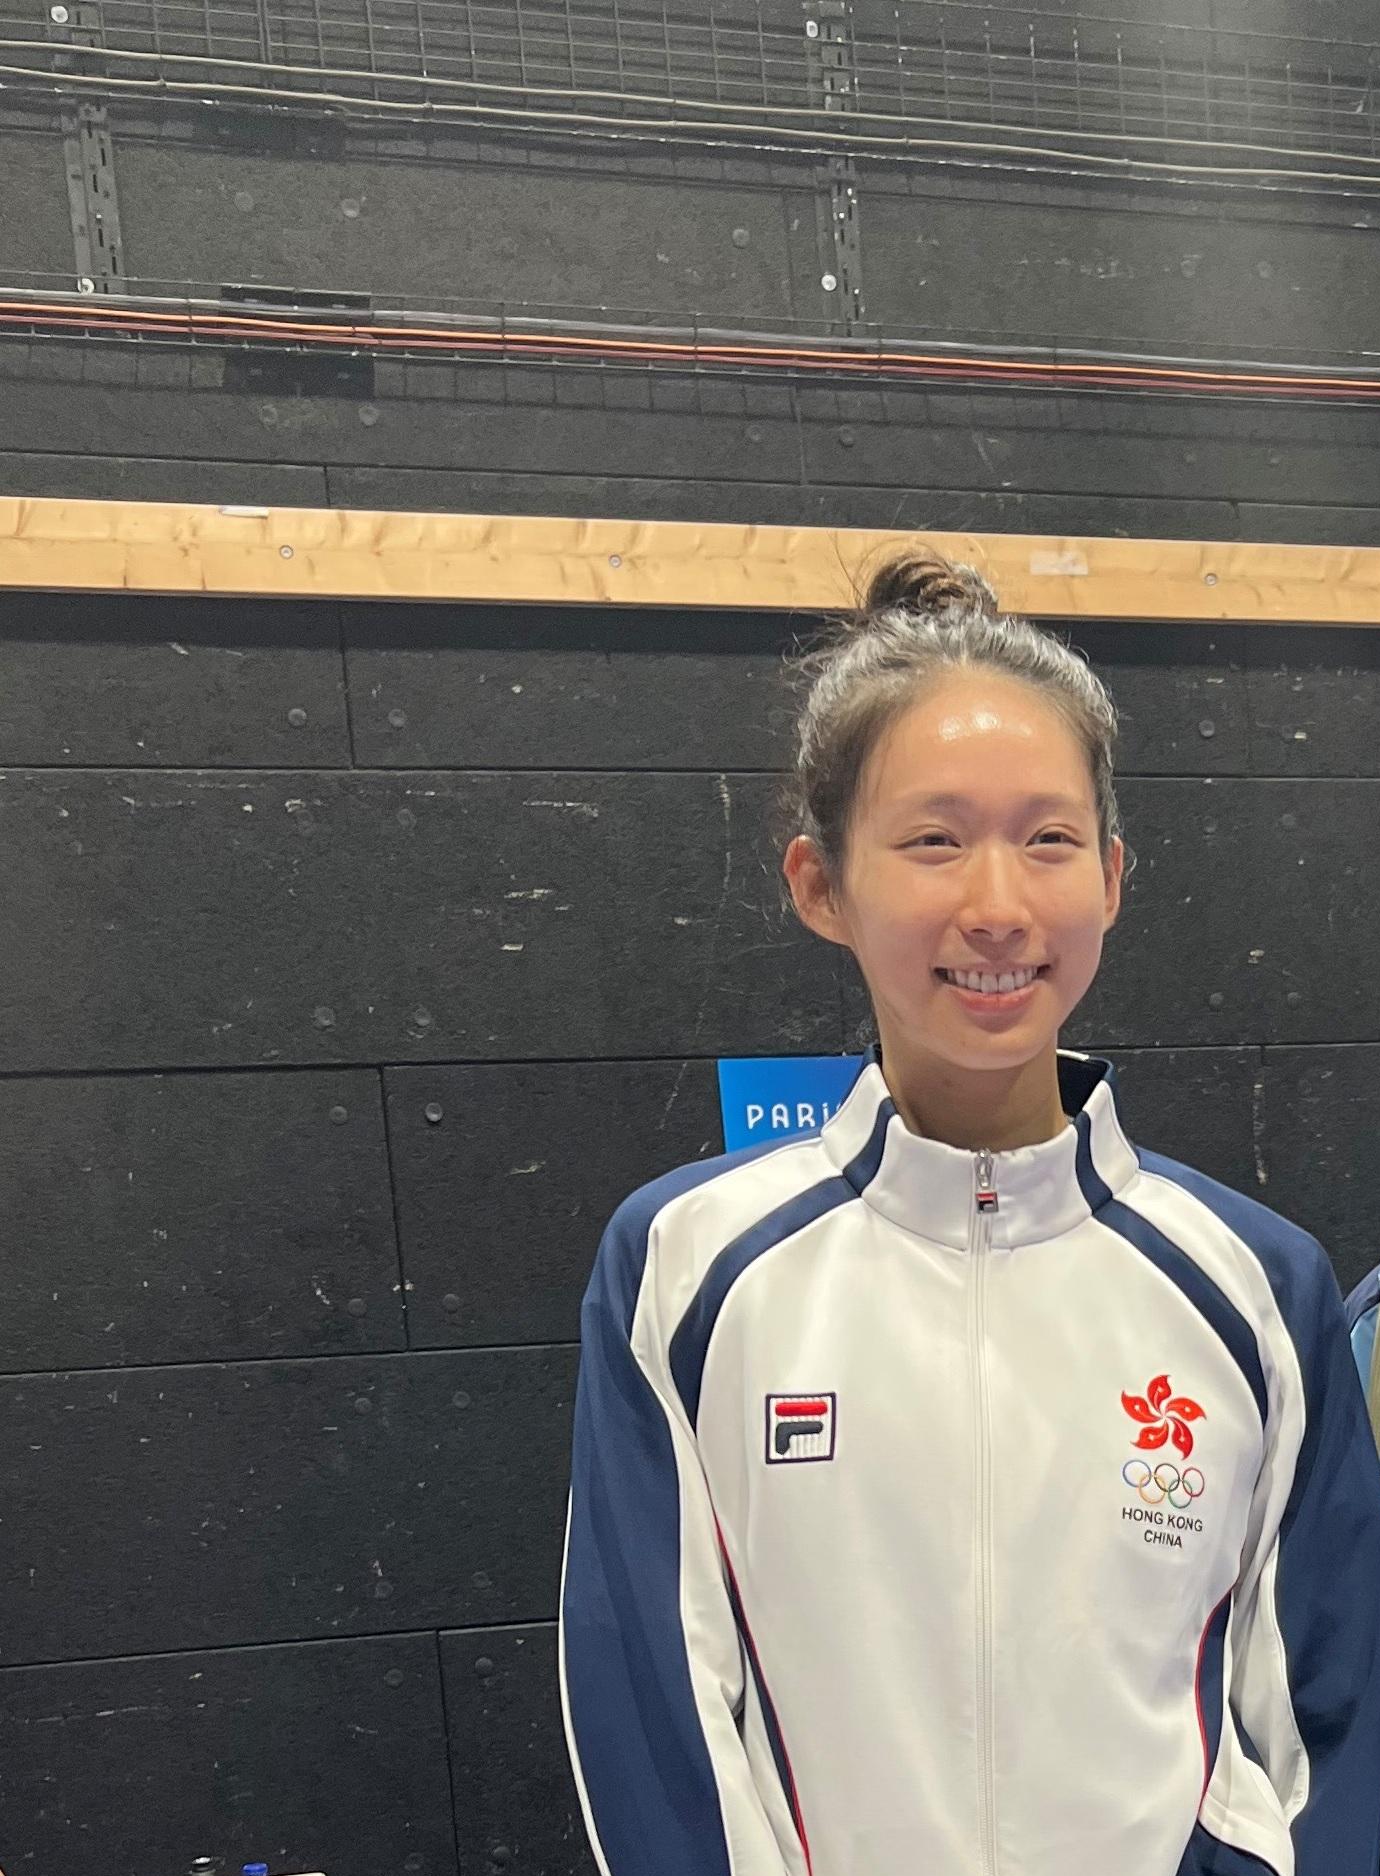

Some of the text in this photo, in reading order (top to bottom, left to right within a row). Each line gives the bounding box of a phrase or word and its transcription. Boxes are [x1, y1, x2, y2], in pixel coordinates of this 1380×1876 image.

[746, 1102, 841, 1130] PARi
[1122, 1507, 1203, 1532] HONG KONG
[1143, 1529, 1183, 1548] CHINA
